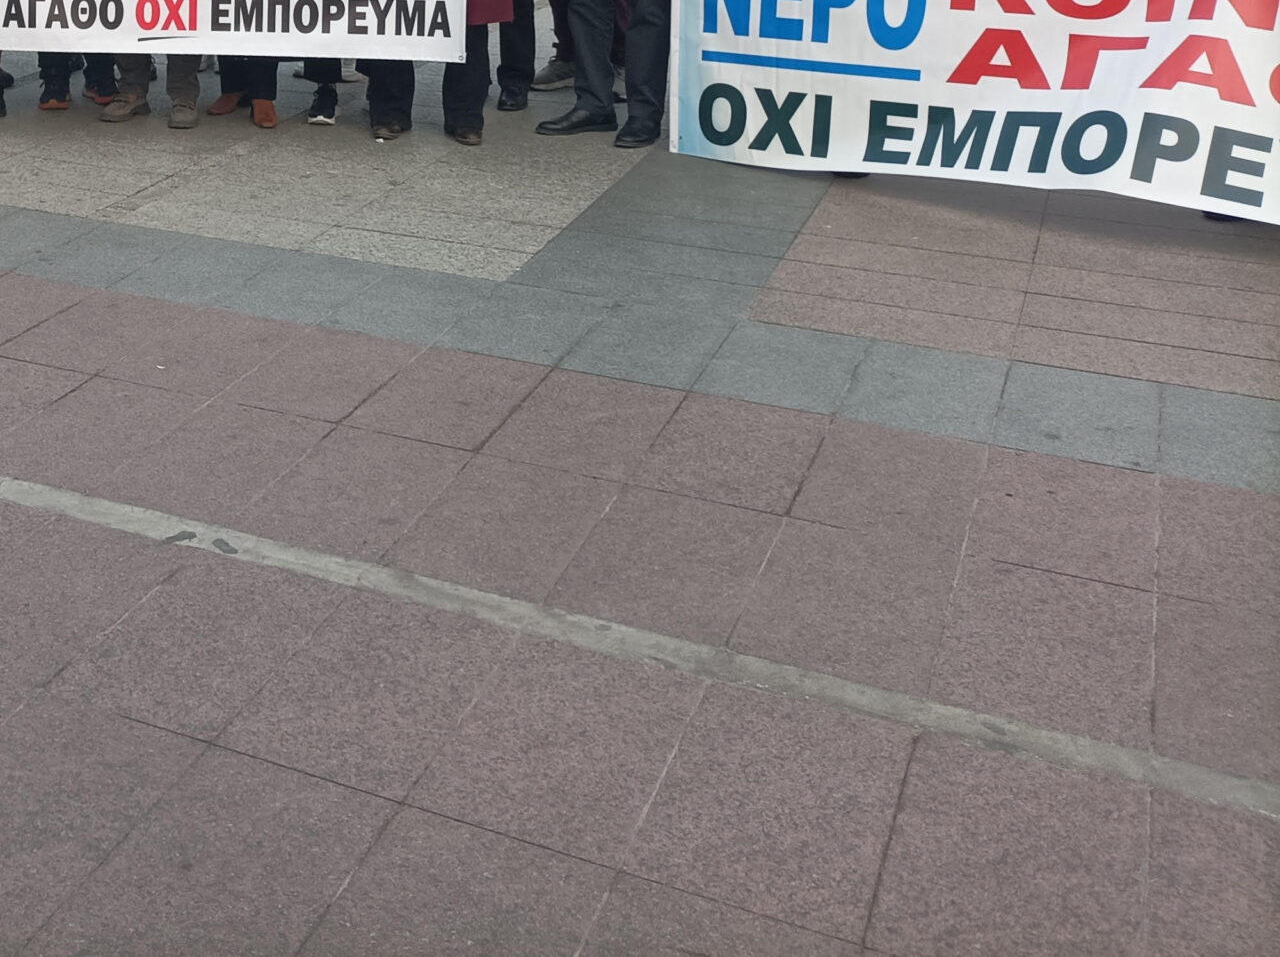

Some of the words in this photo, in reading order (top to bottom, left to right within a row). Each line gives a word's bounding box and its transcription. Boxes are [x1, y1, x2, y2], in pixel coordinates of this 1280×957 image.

[946, 27, 1280, 108] ΑΓΑ
[698, 82, 833, 159] ΟΧΙ
[862, 99, 1280, 208] ΕΜΠΟΡΕ
